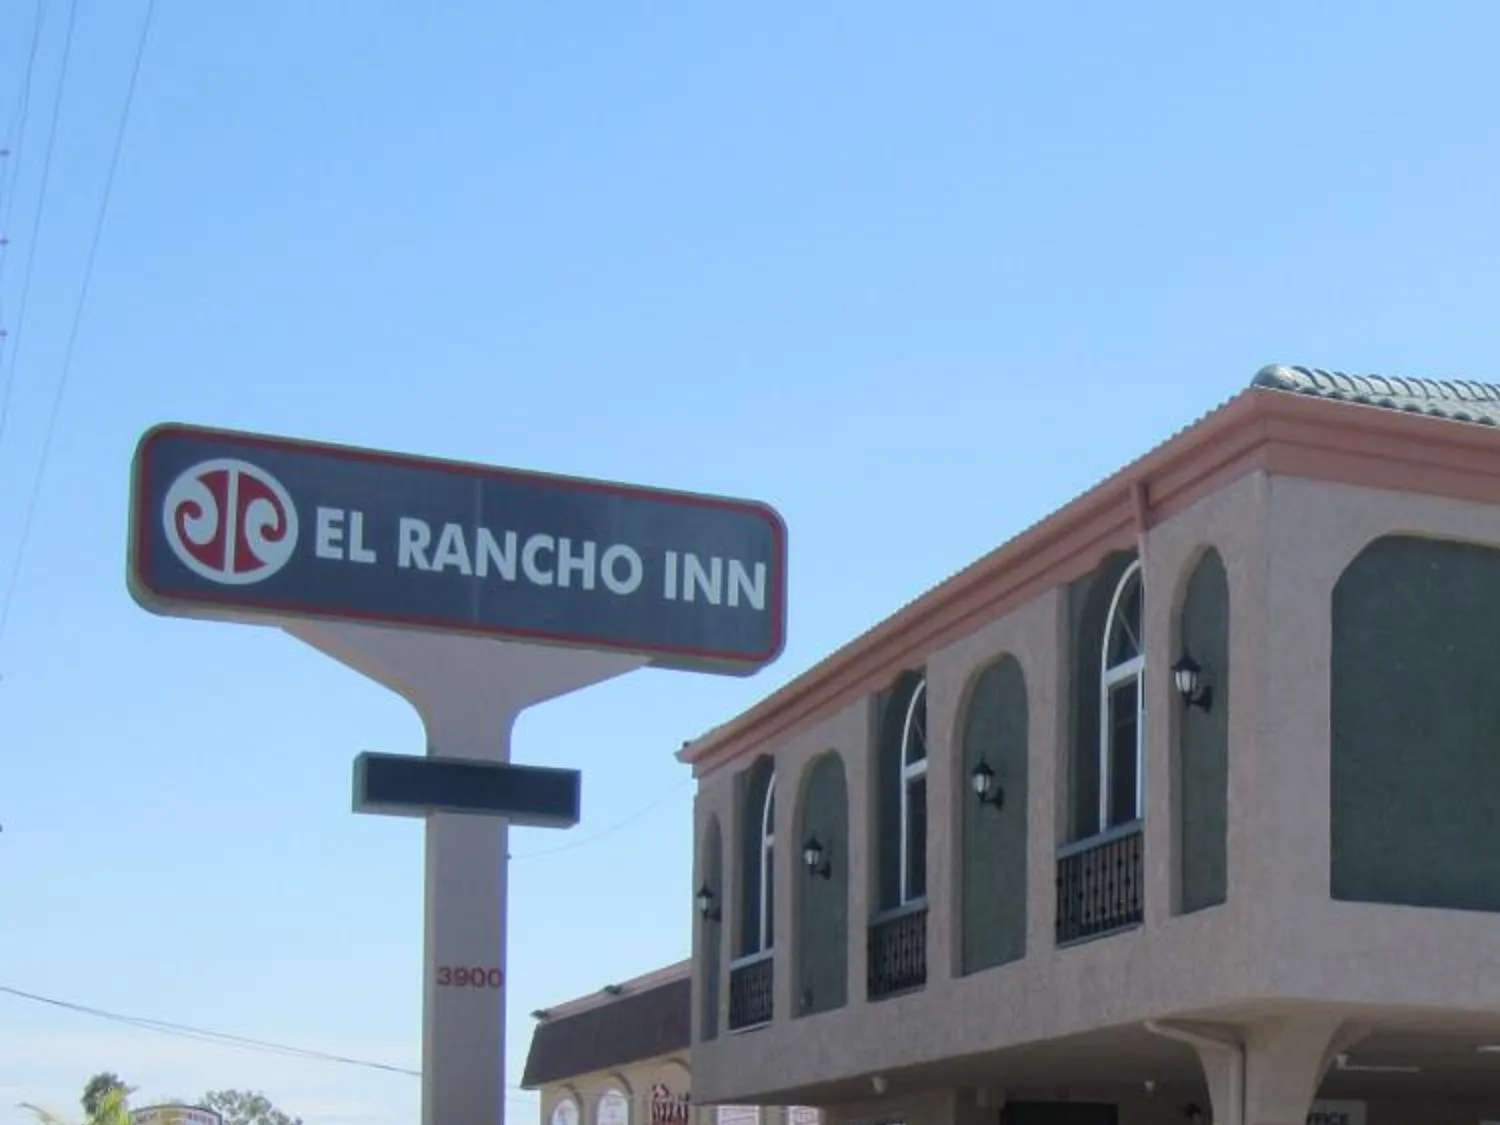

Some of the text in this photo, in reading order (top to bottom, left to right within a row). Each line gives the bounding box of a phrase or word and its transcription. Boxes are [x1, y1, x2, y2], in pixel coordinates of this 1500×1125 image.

[315, 506, 767, 611] EL RANCHO INN
[437, 966, 506, 989] 3900
